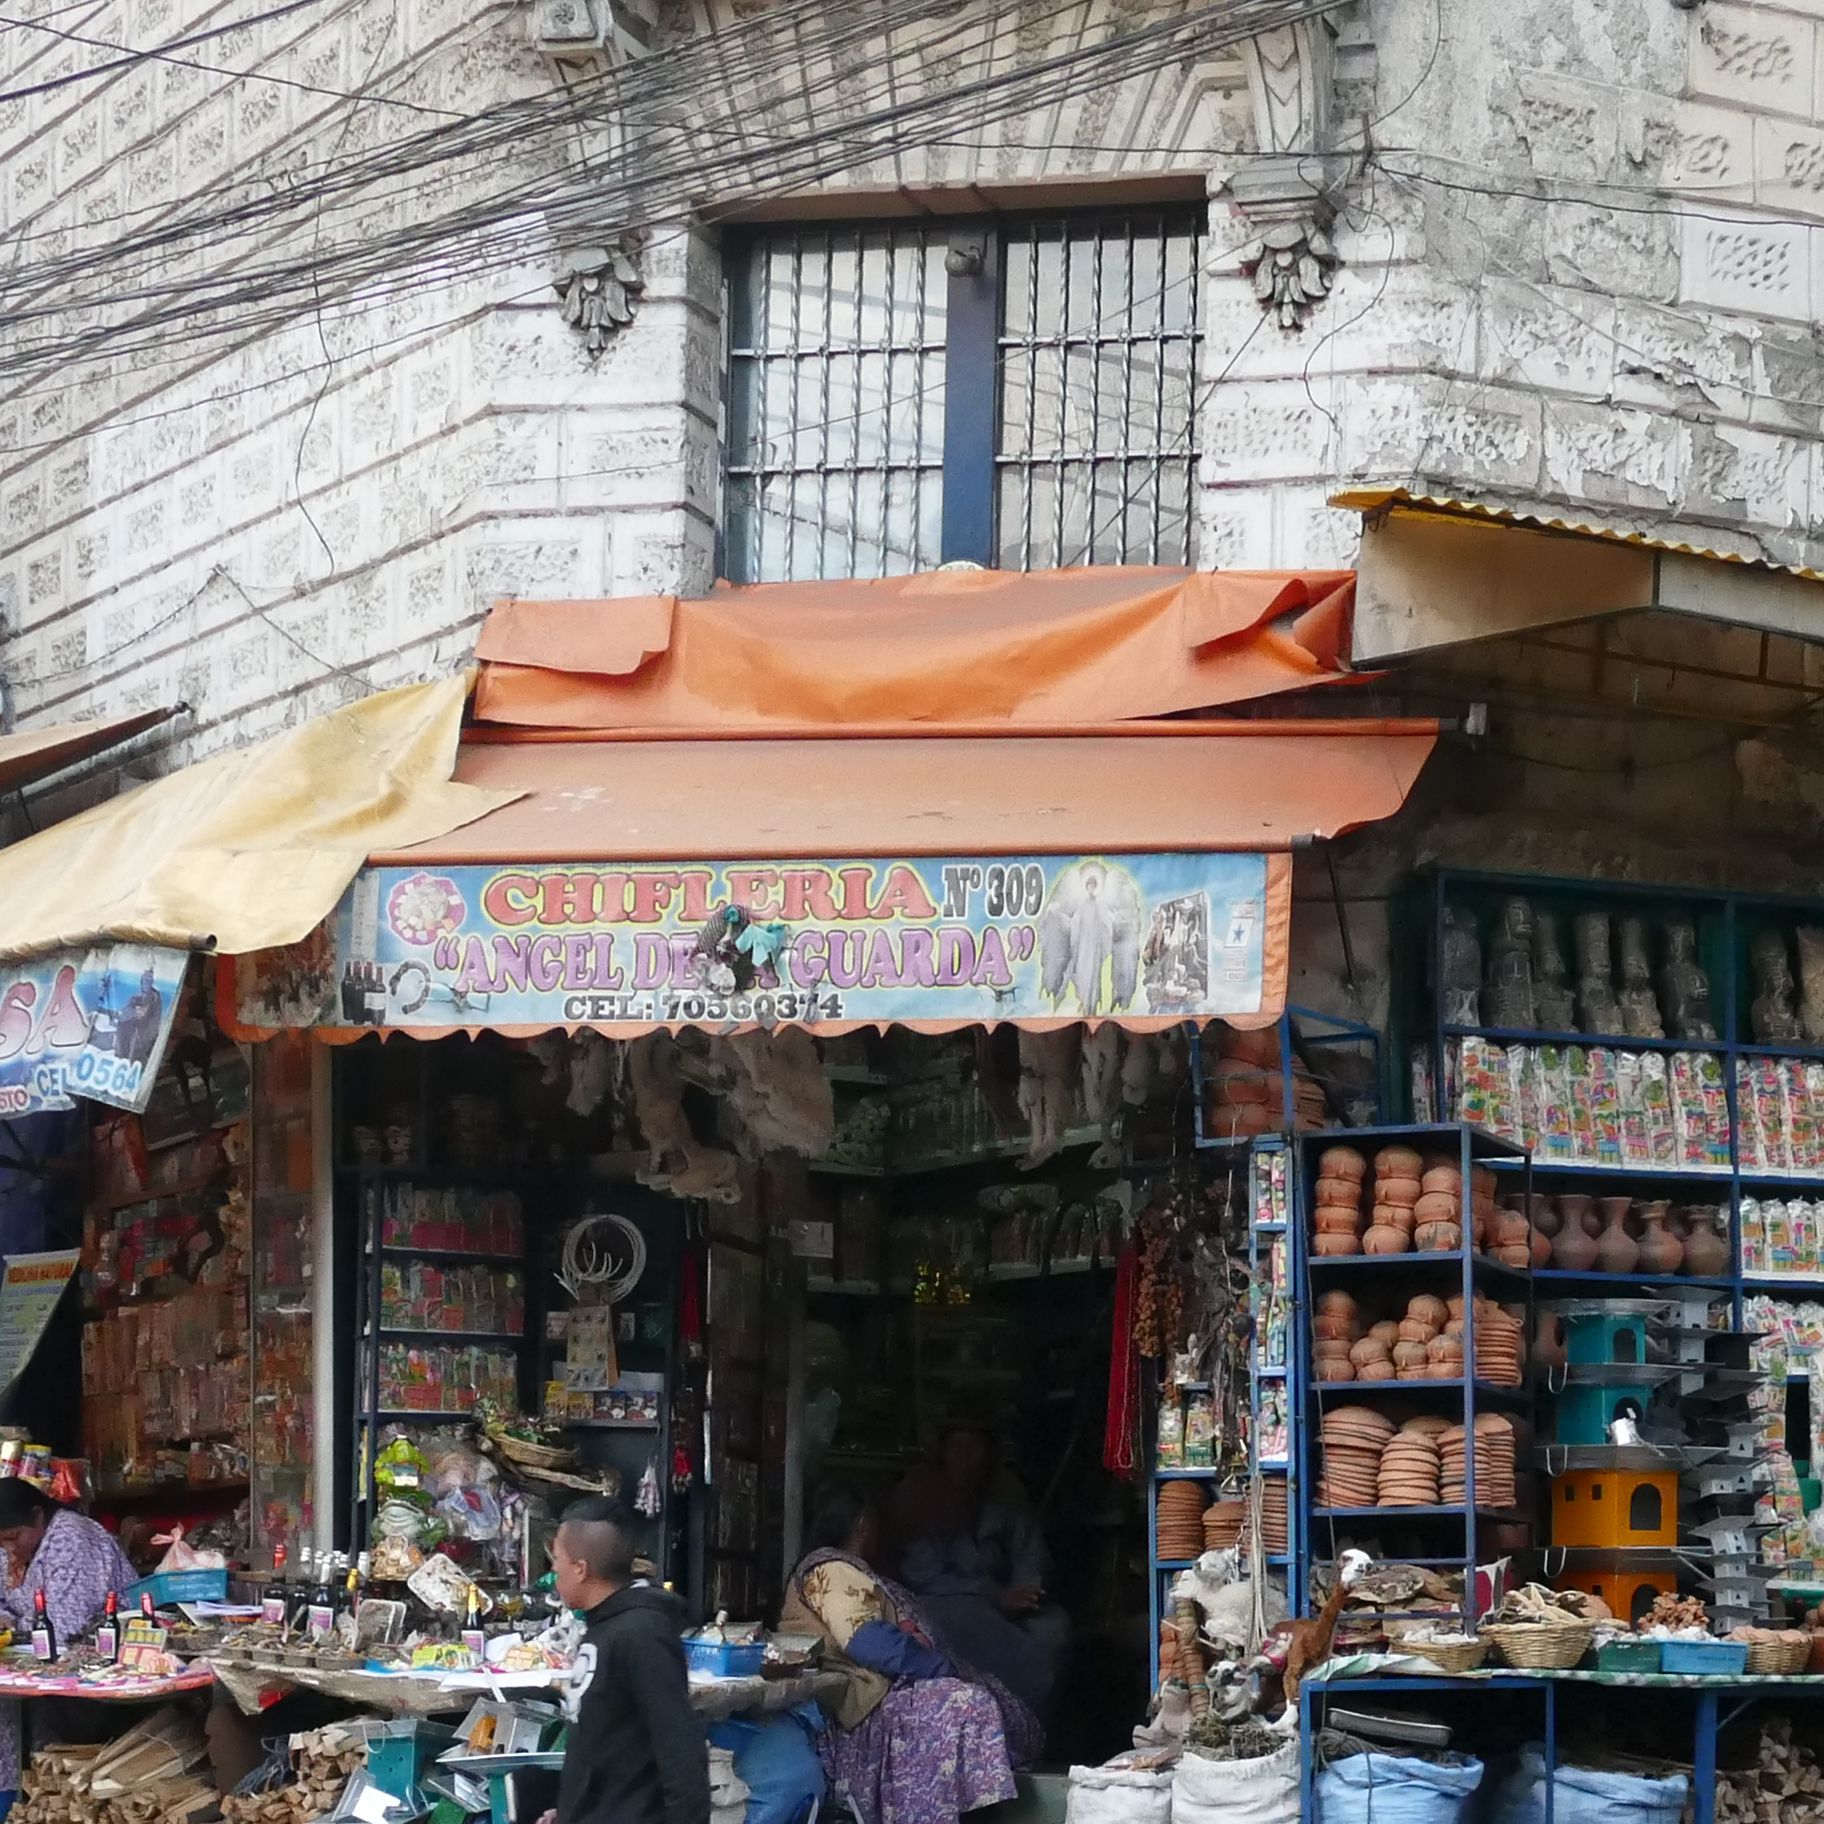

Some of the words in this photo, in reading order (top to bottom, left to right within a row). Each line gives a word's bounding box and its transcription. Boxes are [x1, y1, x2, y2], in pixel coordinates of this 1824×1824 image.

[483, 867, 937, 924] CHIFLERIA
[988, 863, 1044, 918] 309
[564, 994, 654, 1022] CEL:
[76, 1052, 142, 1093] 0564
